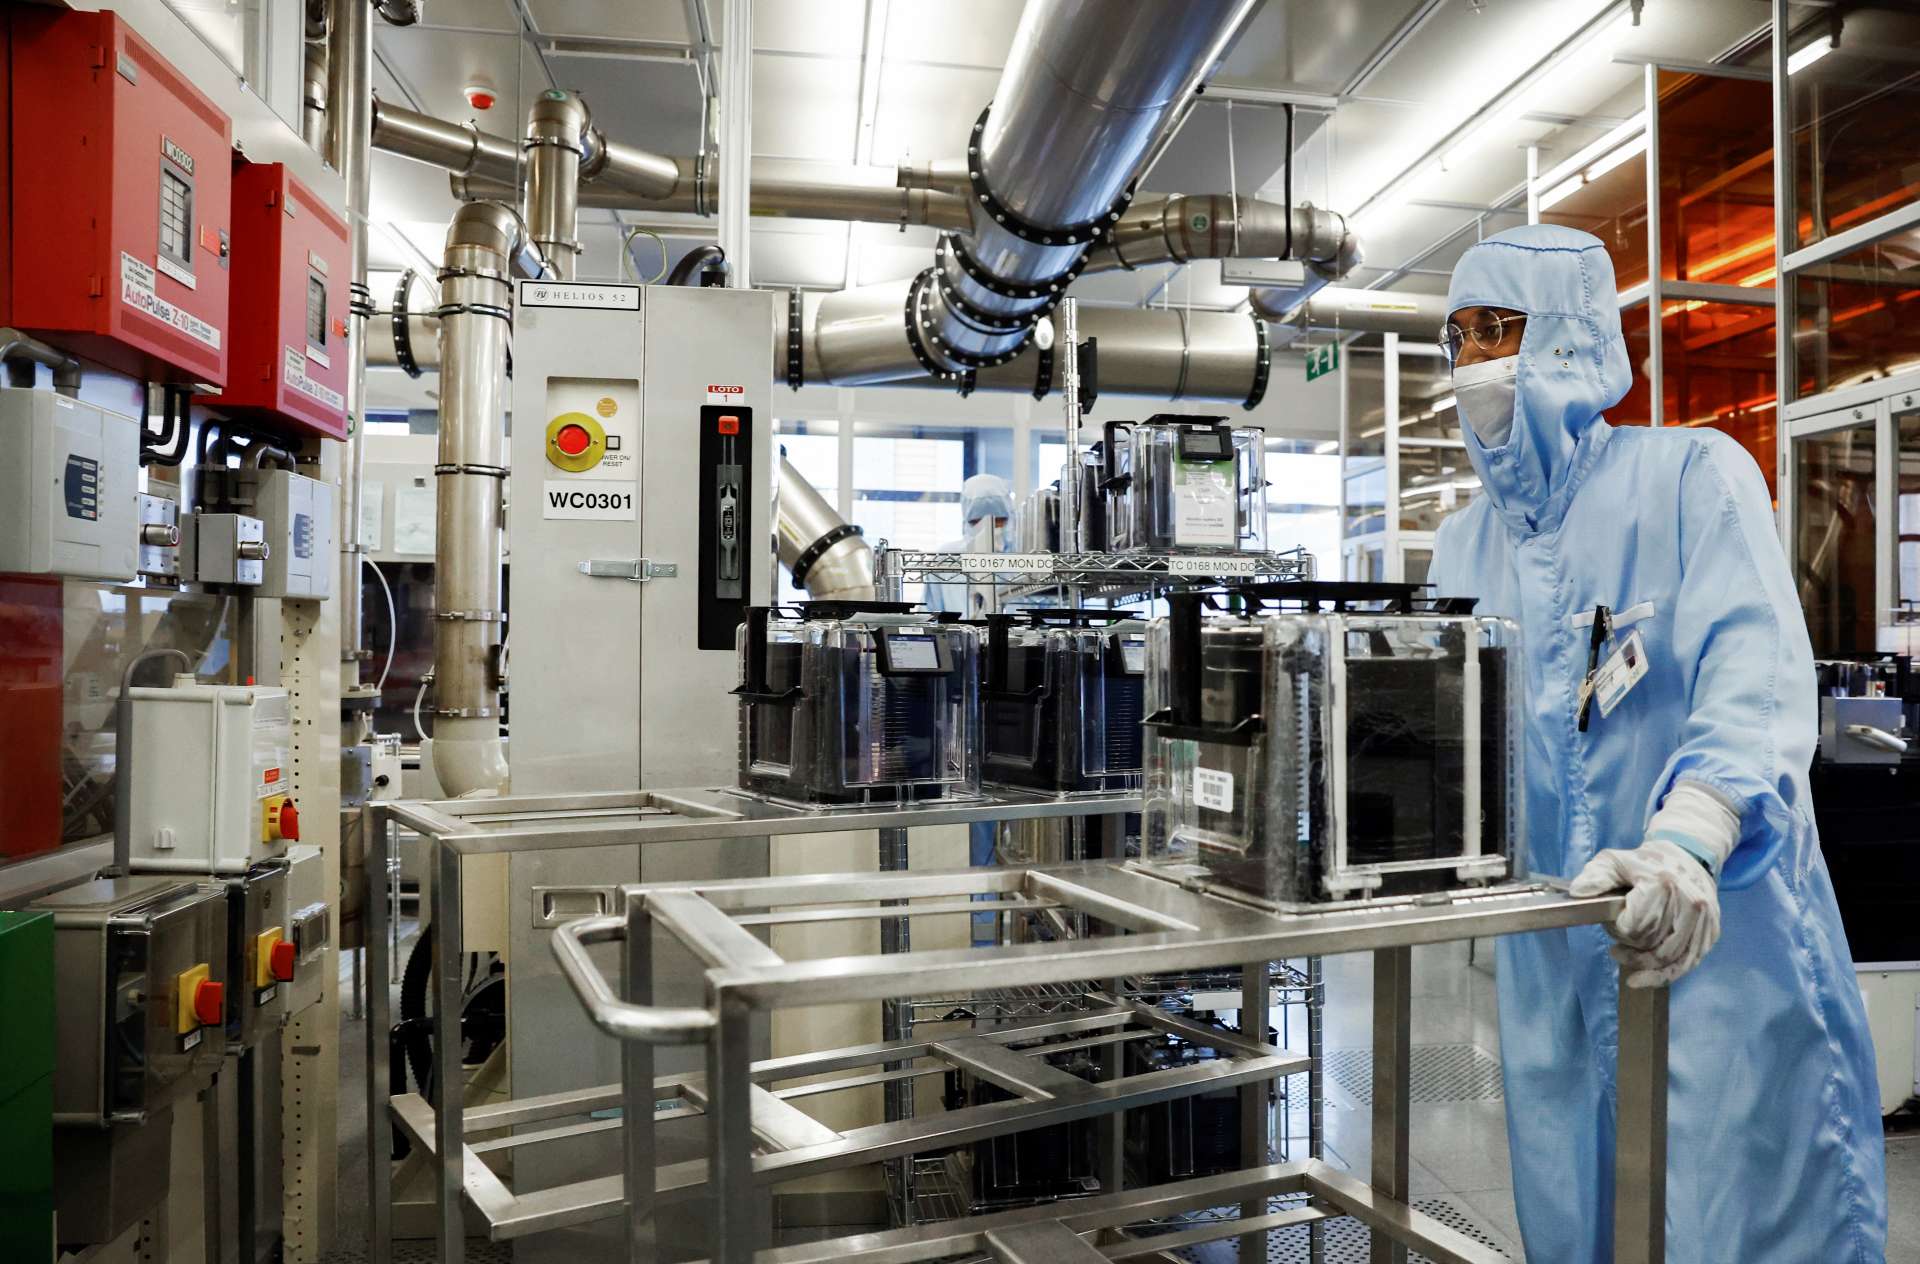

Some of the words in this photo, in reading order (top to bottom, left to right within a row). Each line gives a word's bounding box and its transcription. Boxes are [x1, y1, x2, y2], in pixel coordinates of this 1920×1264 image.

[553, 291, 604, 301] HELIOS
[612, 294, 626, 302] 52
[125, 284, 170, 321] AutoPulse
[172, 308, 189, 330] Z-10
[549, 492, 631, 509] WC0301
[962, 558, 977, 568] TC
[980, 558, 1005, 569] 0167
[1008, 559, 1034, 569] MON
[1170, 560, 1184, 570] TC
[1186, 561, 1210, 571] 0168
[1213, 562, 1237, 571] MON
